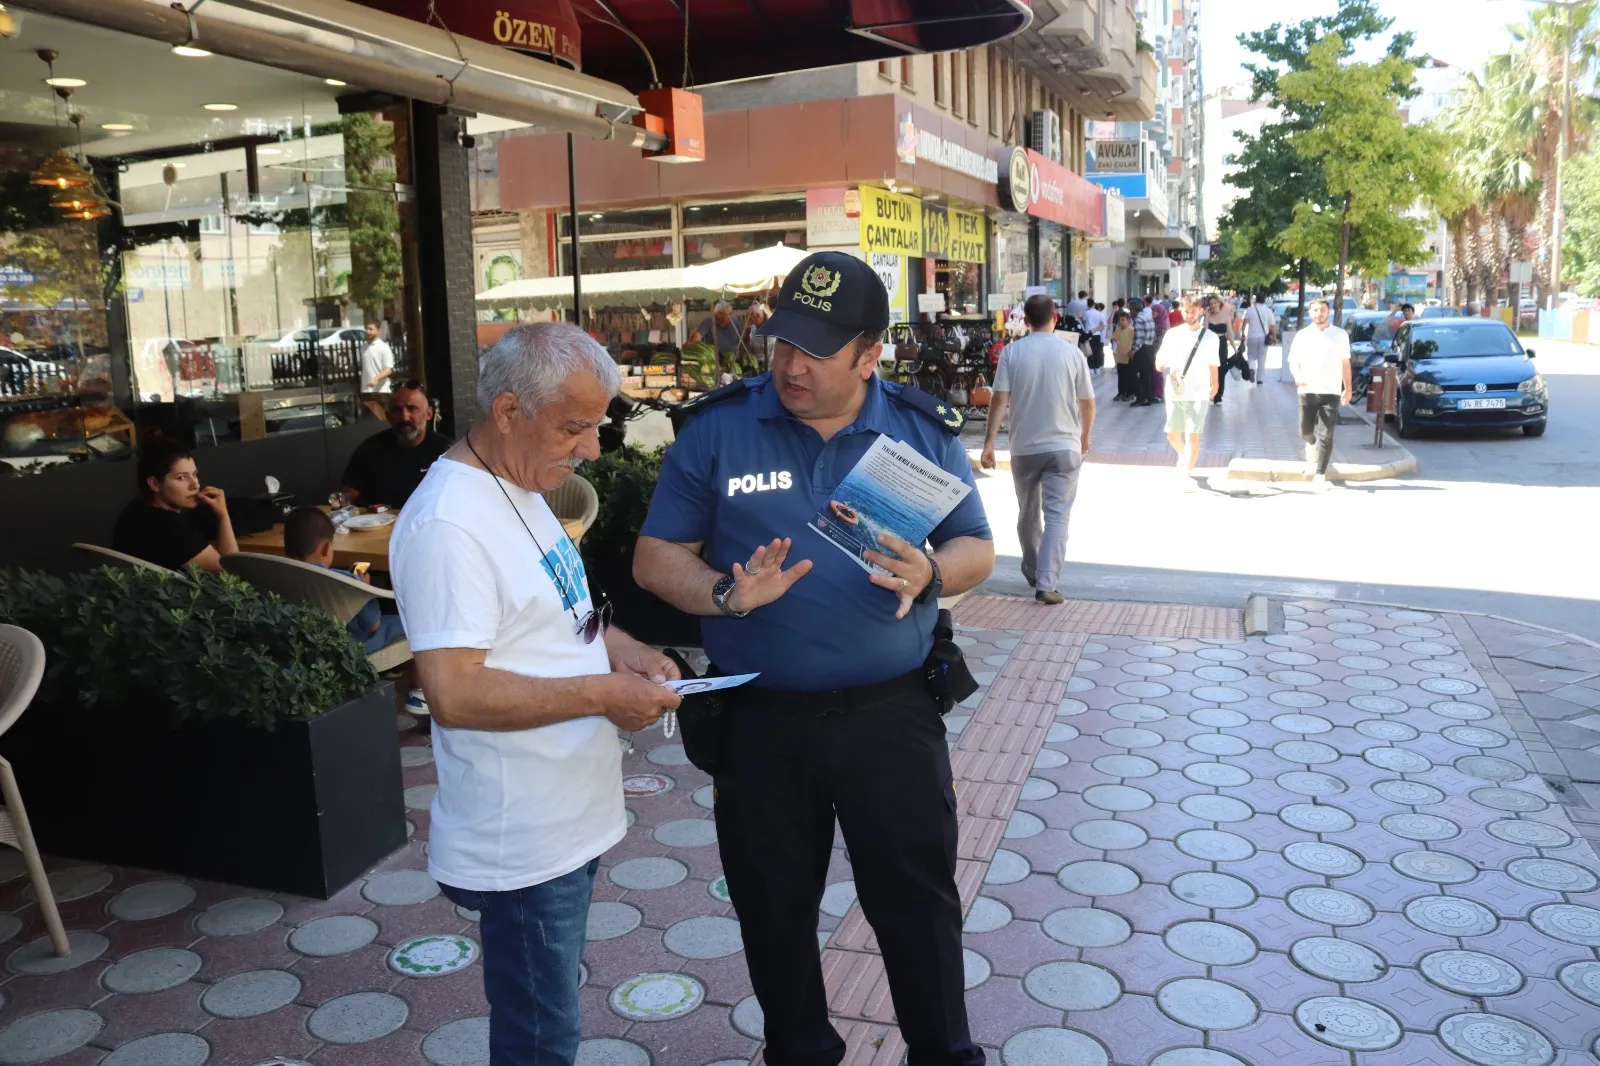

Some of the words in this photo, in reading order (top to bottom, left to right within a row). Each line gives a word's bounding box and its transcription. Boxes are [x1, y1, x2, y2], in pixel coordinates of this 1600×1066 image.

[493, 10, 556, 51] ÖZEN
[1098, 144, 1137, 158] AVUKAT
[876, 194, 912, 223] BÜTÜN
[866, 224, 919, 251] ÇANTALAR
[956, 213, 978, 235] TEK
[951, 235, 983, 262] FİYAT
[1463, 400, 1471, 408] 34
[1486, 399, 1504, 408] 7475
